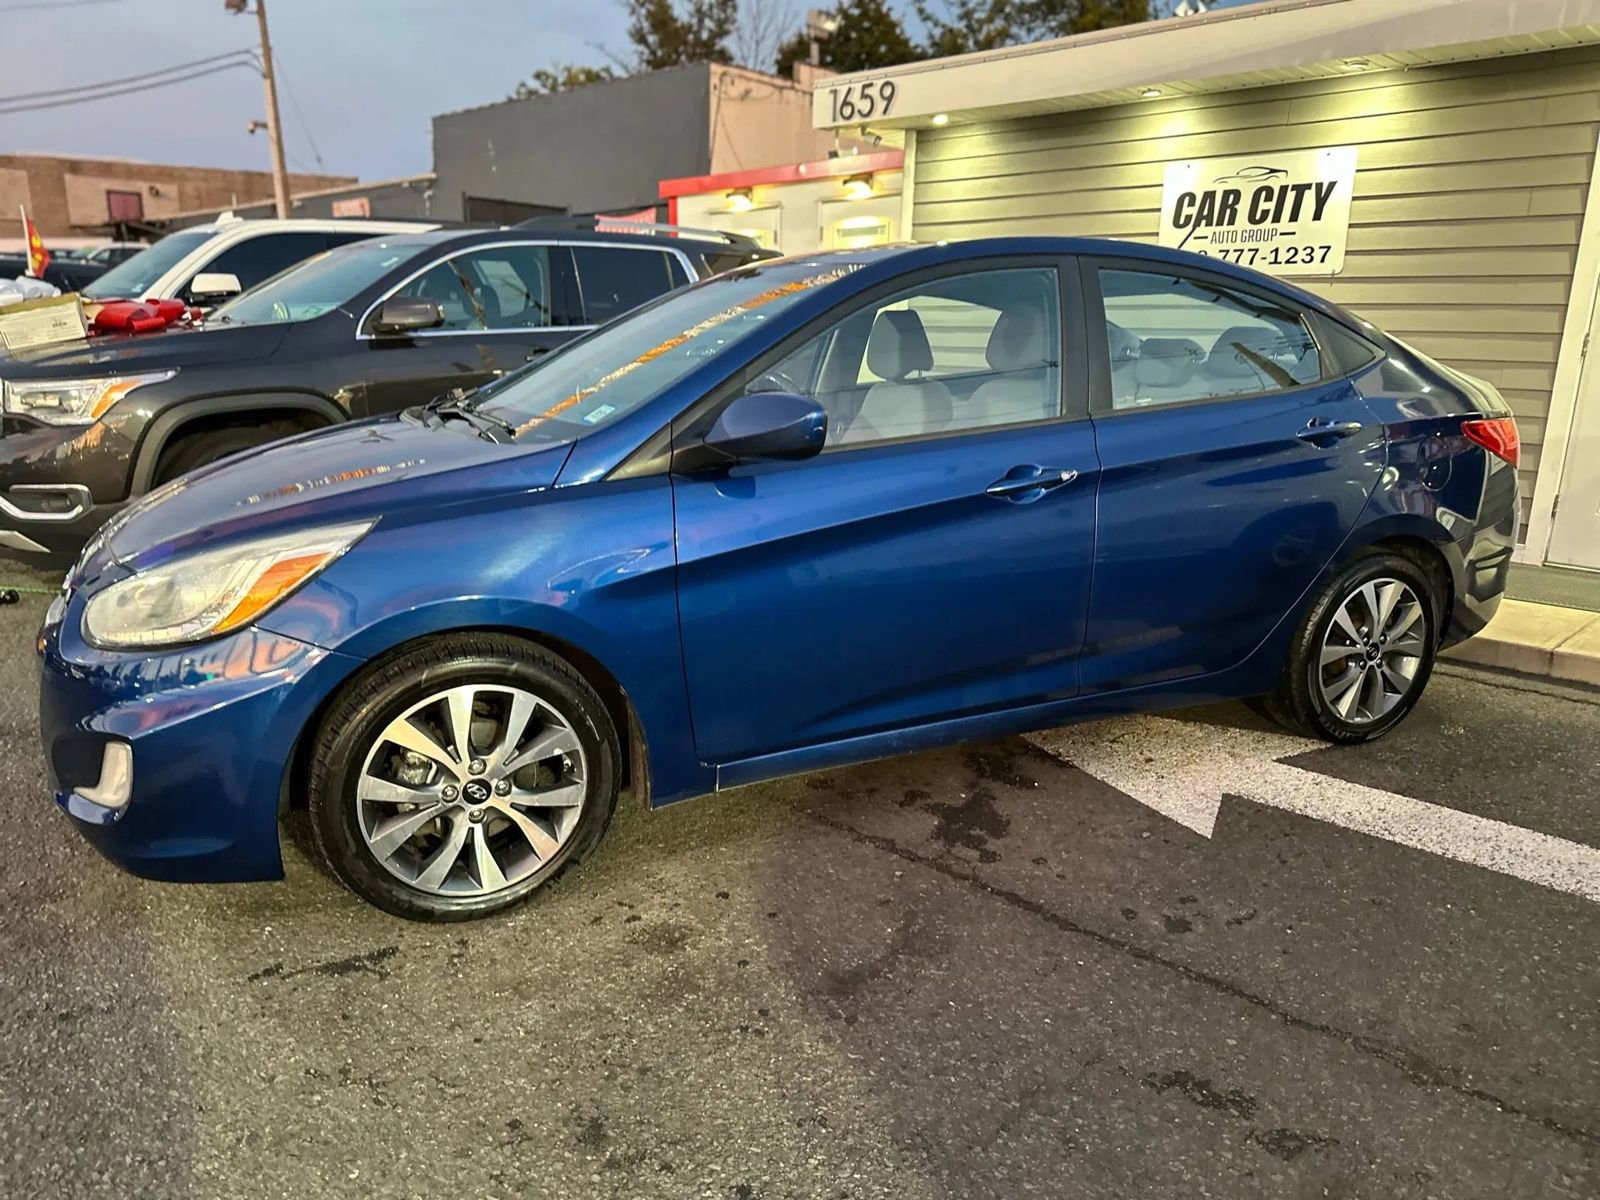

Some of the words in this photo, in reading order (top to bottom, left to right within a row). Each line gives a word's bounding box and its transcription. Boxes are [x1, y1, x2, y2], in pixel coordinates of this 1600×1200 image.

[829, 80, 895, 122] 1659
[1172, 188, 1242, 230] CAR
[1247, 180, 1338, 226] CITY
[1210, 229, 1238, 244] AUTO
[1240, 227, 1278, 243] GROUP
